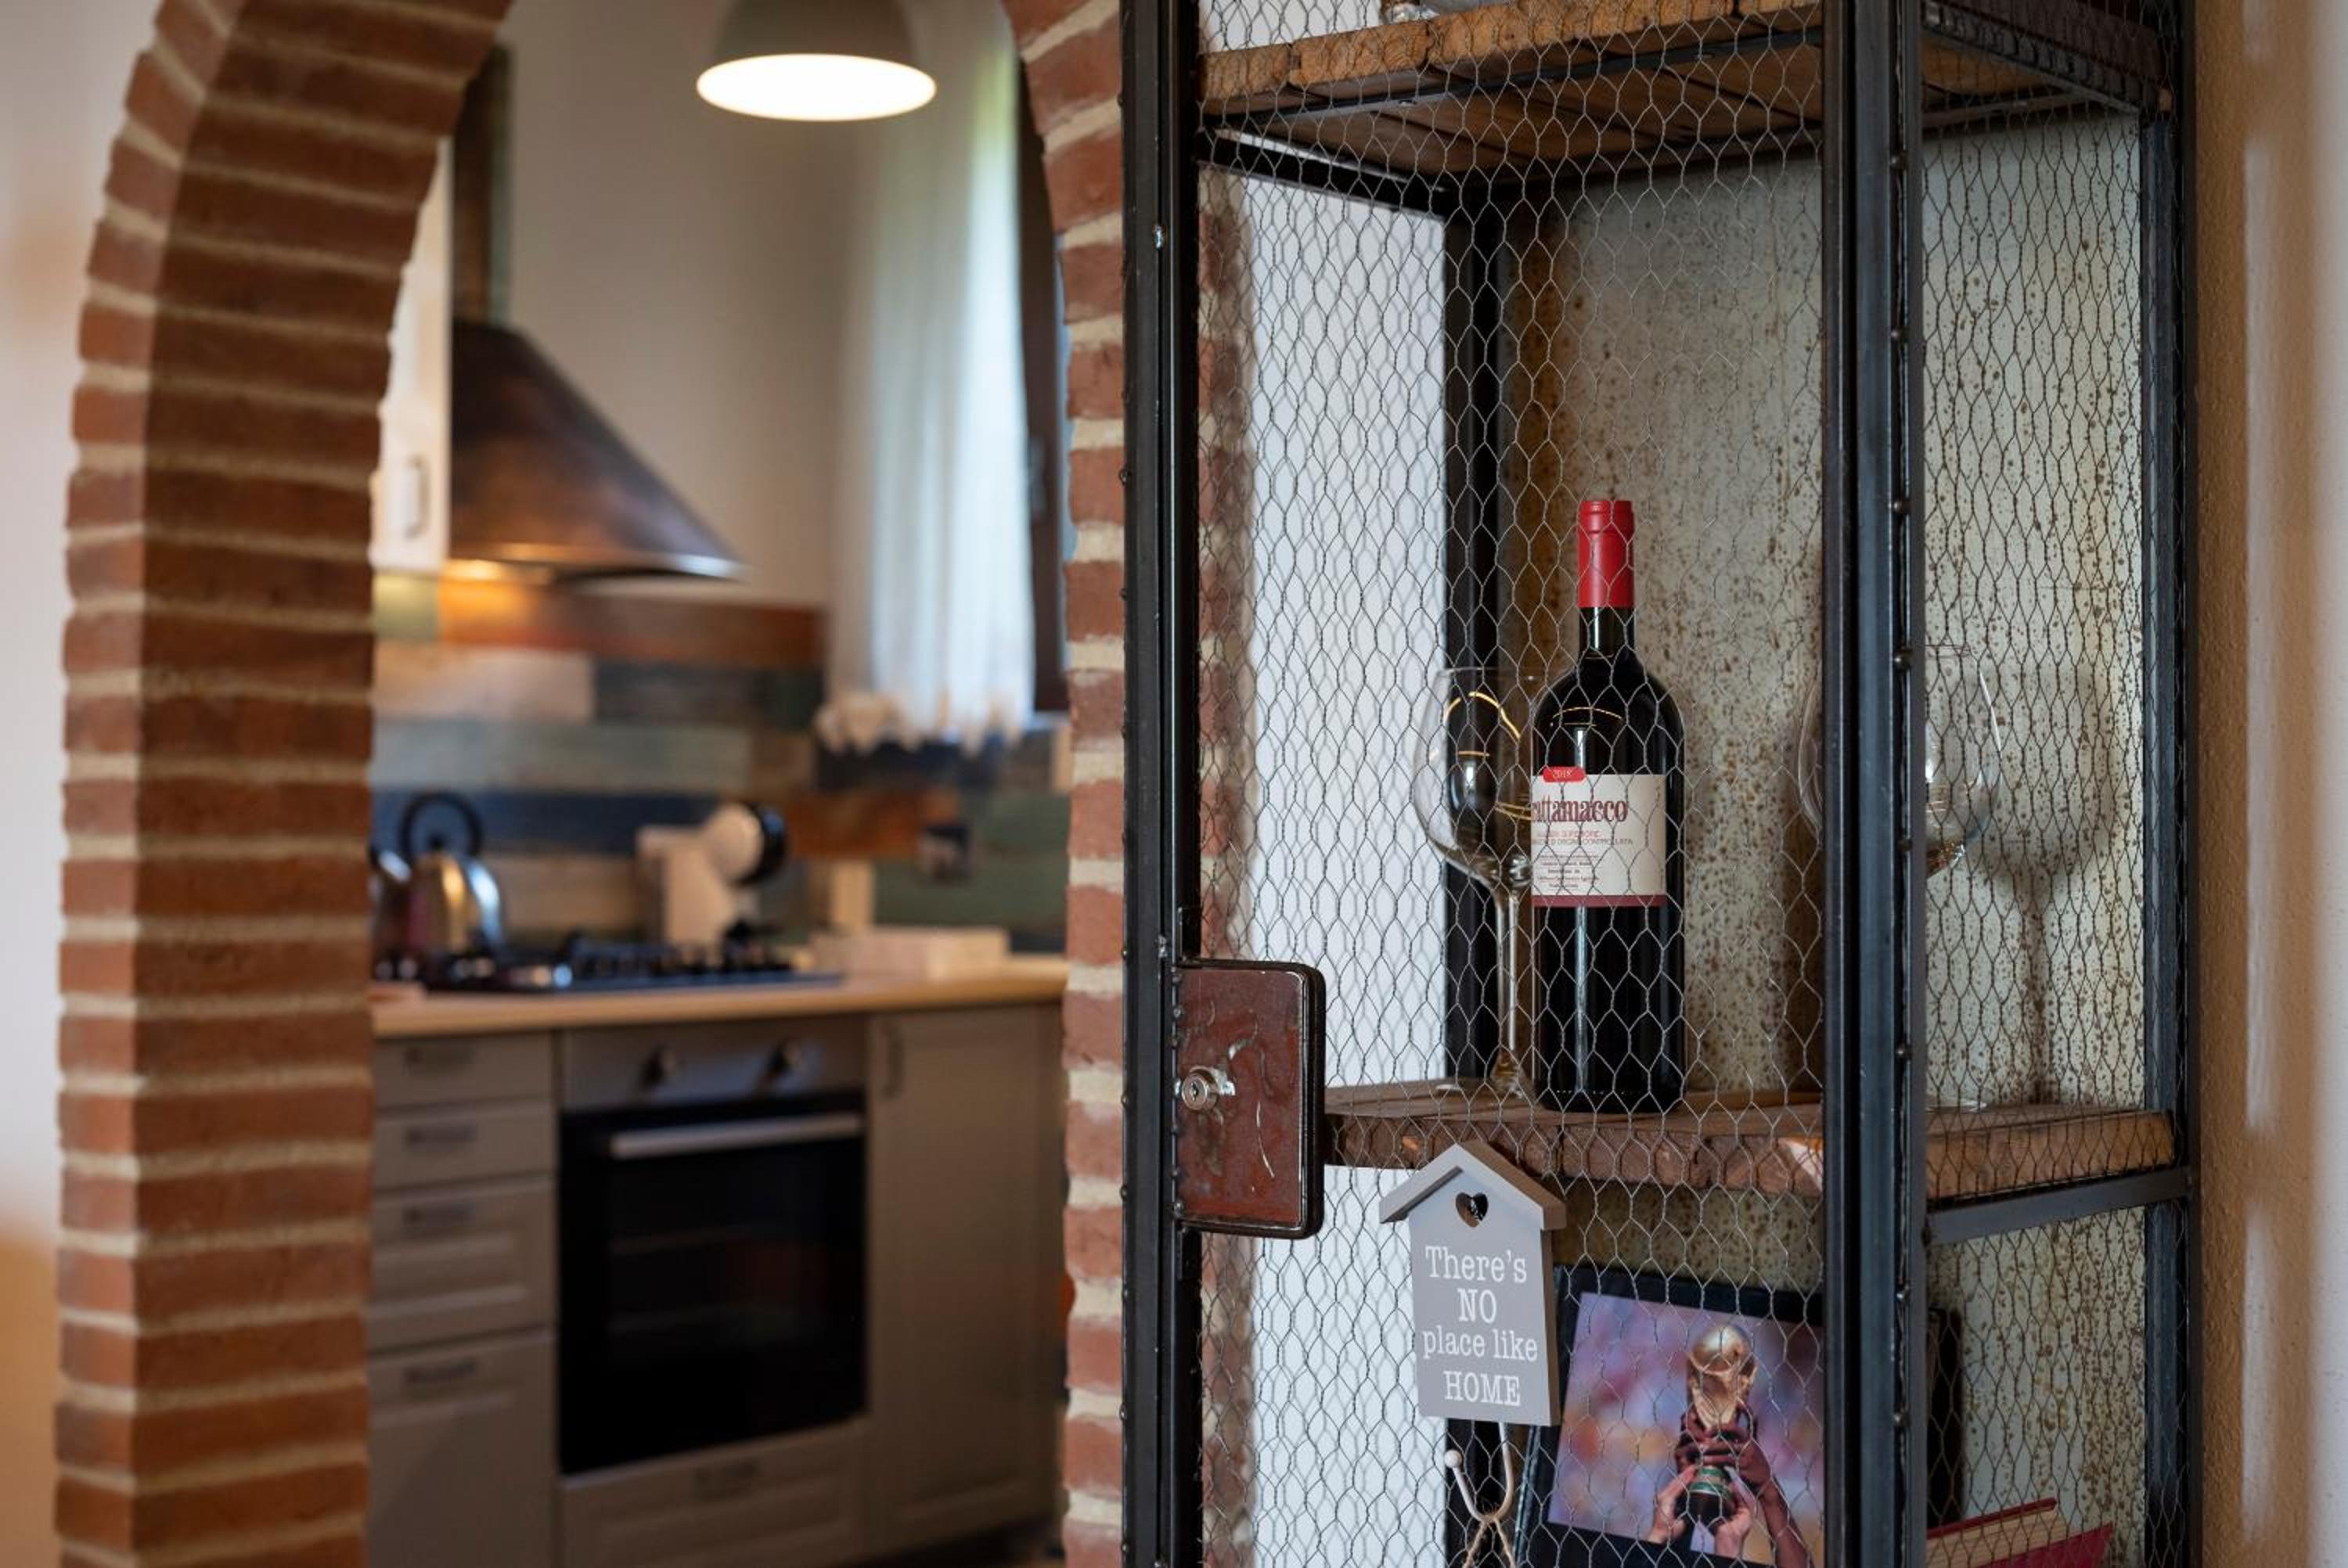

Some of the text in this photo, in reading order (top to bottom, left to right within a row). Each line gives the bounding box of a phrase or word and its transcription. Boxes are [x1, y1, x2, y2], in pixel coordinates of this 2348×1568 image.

[1425, 1245, 1527, 1283] There's
[1457, 1288, 1497, 1324] NO
[1422, 1325, 1538, 1362] place like
[1442, 1370, 1522, 1407] HOME
